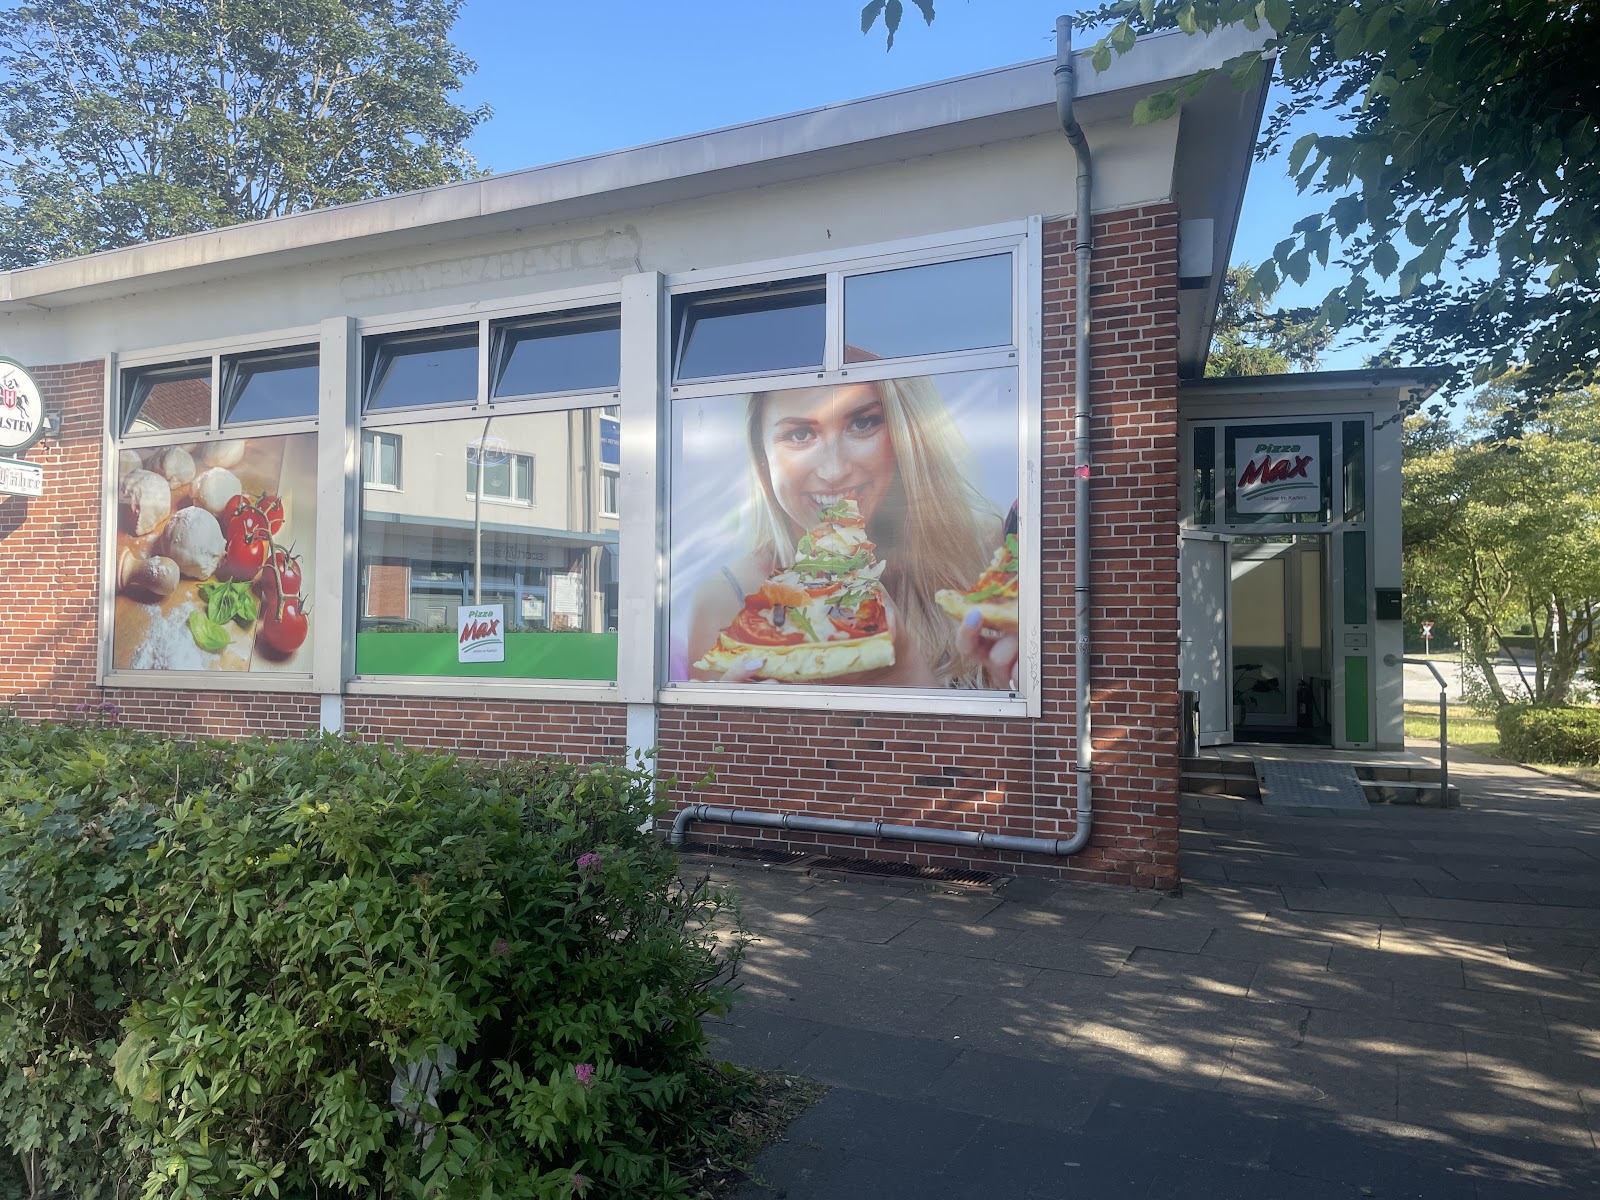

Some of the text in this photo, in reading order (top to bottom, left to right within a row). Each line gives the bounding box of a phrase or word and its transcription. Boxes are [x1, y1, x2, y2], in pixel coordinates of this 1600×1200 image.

[1255, 444, 1301, 453] Pizza
[1238, 455, 1313, 488] Max
[469, 610, 493, 618] Pizza
[460, 619, 500, 643] Max
